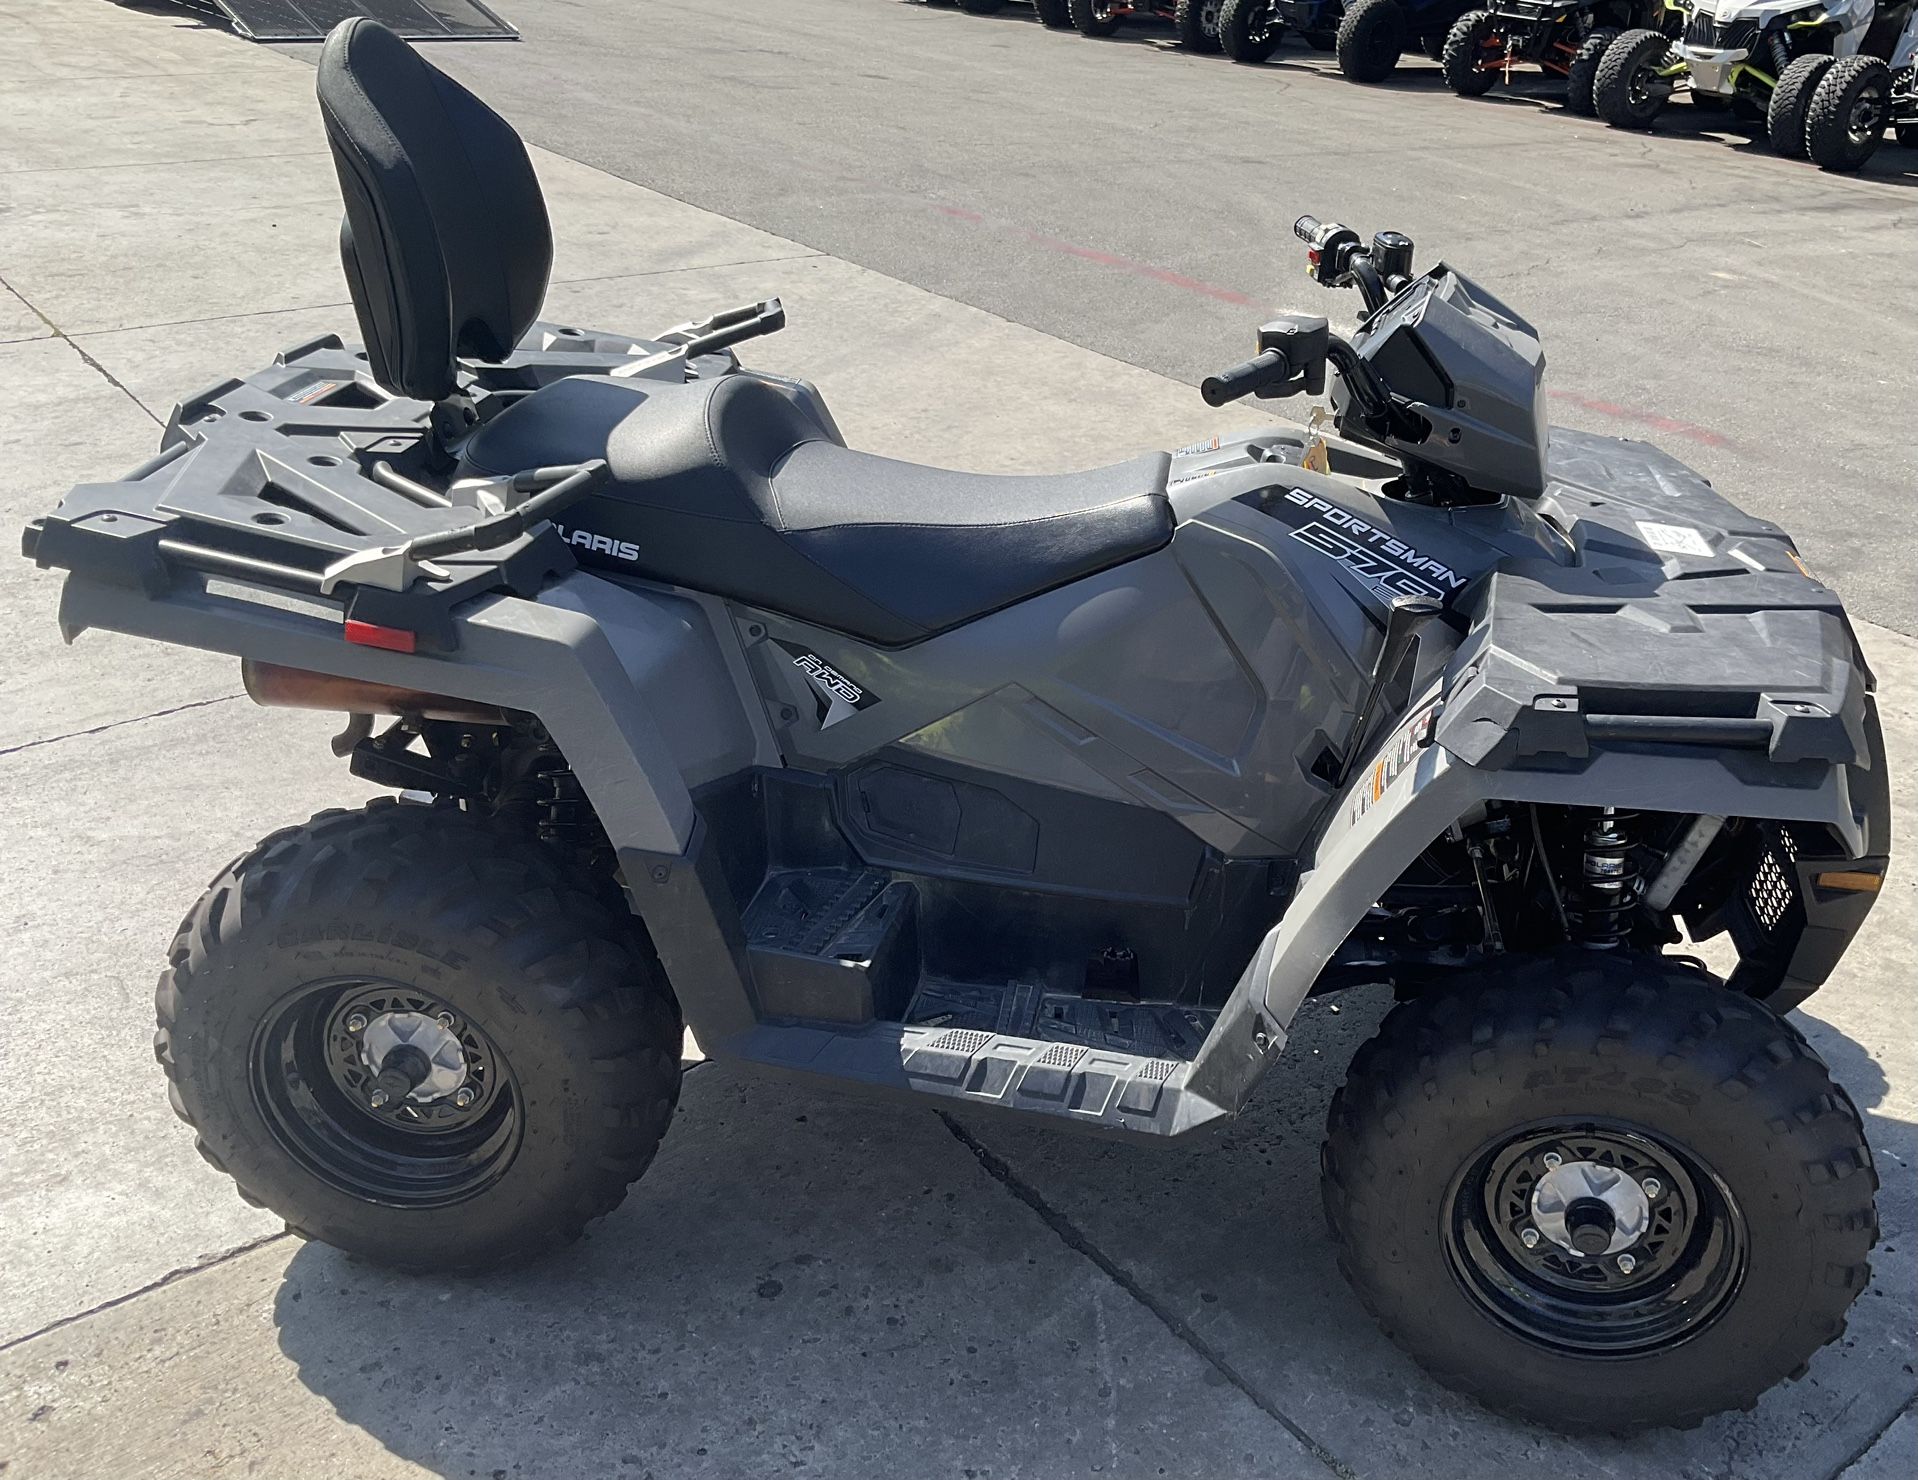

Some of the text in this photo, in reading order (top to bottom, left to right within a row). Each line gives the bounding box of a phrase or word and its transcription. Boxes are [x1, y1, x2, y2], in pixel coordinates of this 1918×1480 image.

[551, 521, 640, 561] LARIS
[1284, 487, 1467, 589] SPORTSMAN
[1288, 521, 1446, 601] 570
[793, 655, 861, 703] AWD
